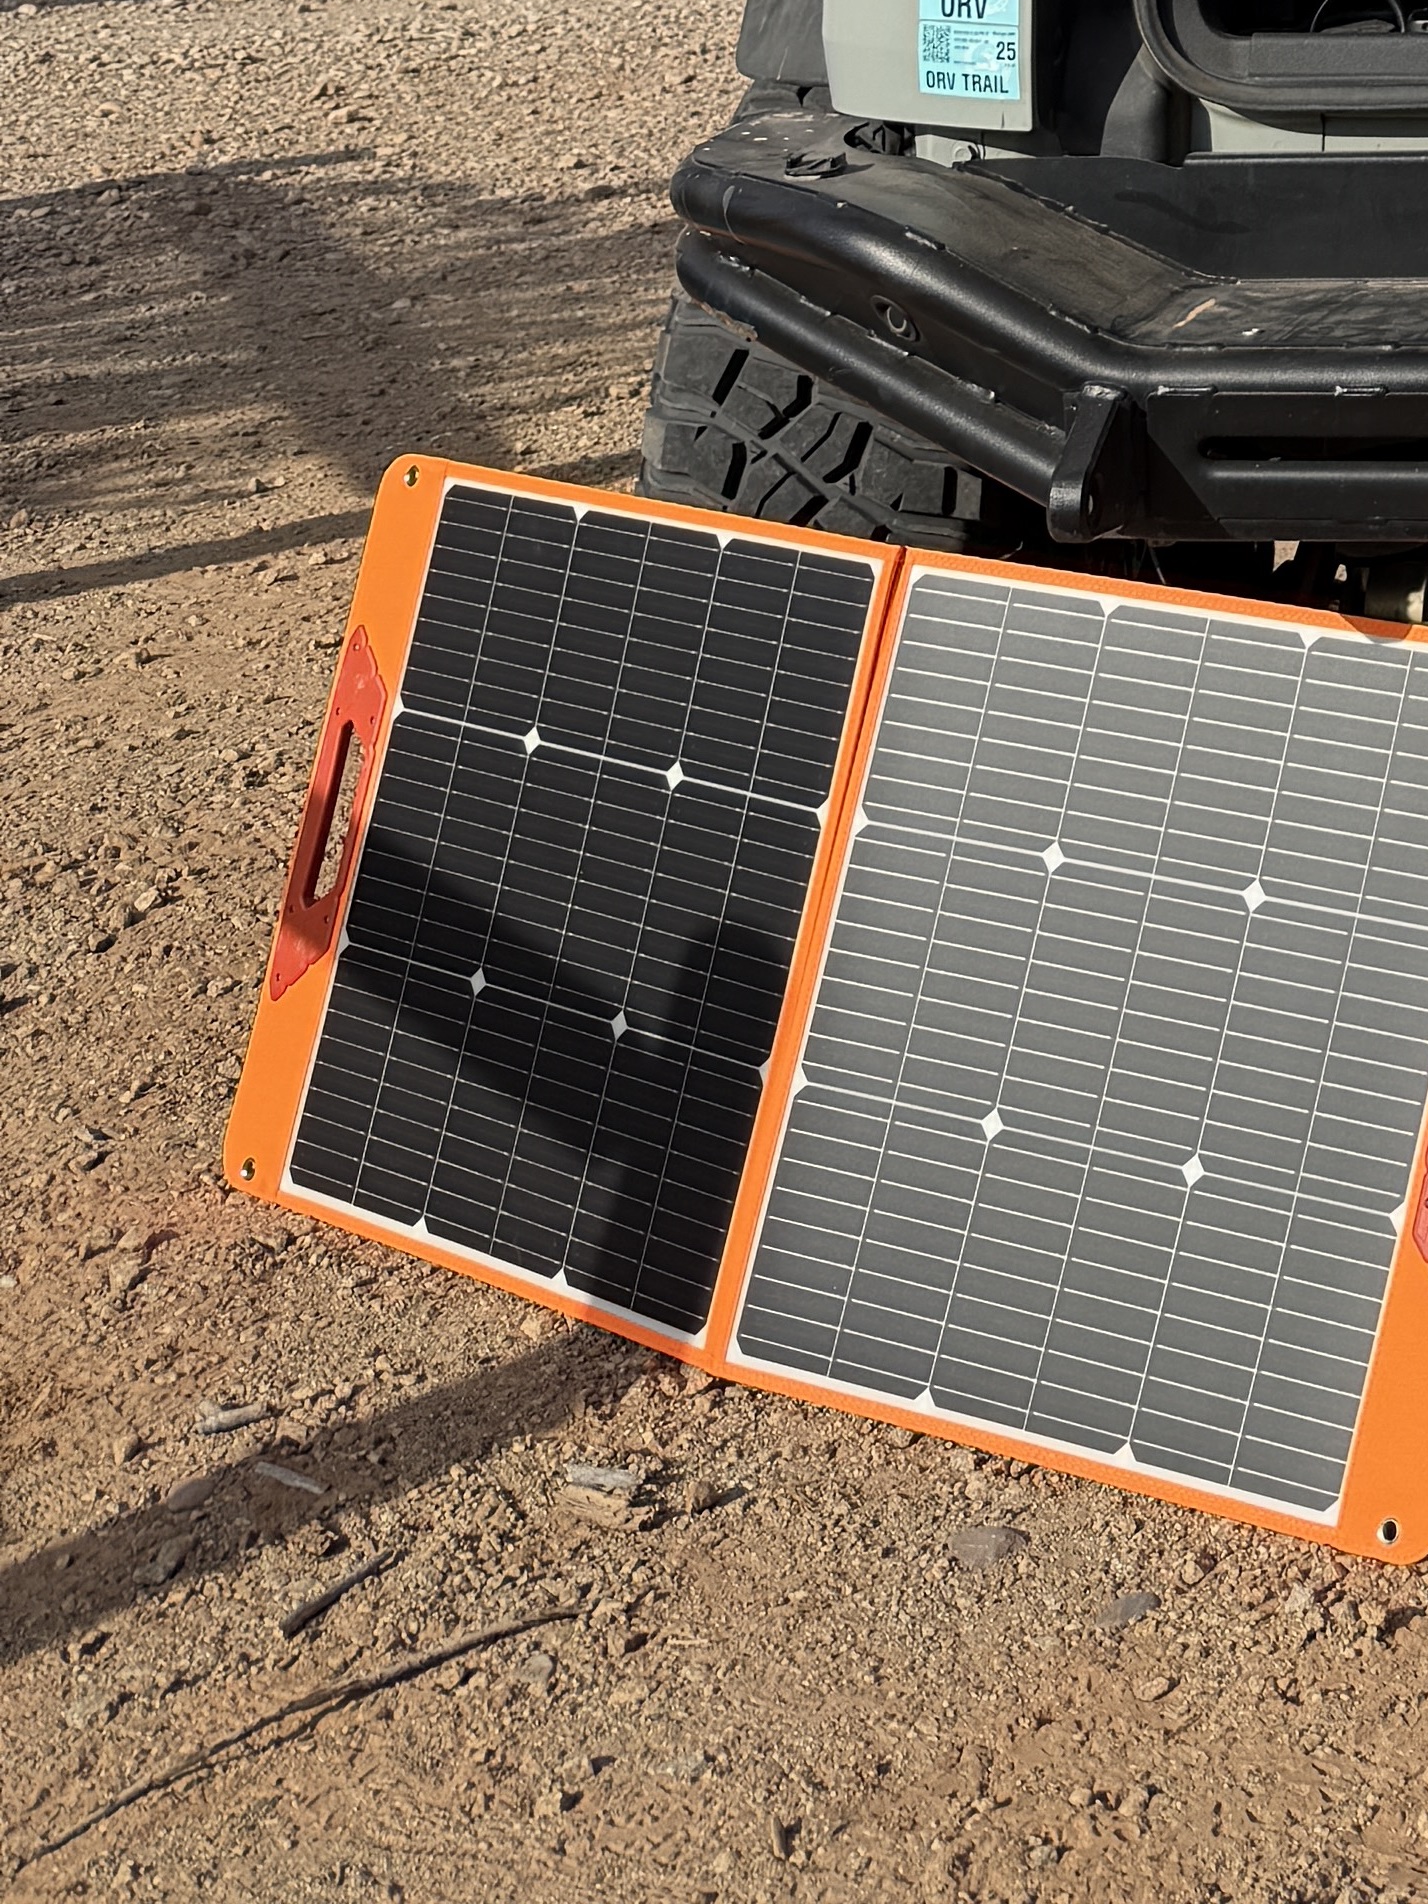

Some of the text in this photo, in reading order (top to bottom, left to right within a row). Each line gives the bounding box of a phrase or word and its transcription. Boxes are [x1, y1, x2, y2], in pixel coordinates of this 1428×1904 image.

[996, 40, 1017, 61] 25
[926, 70, 1010, 94] ORV TRAIL
